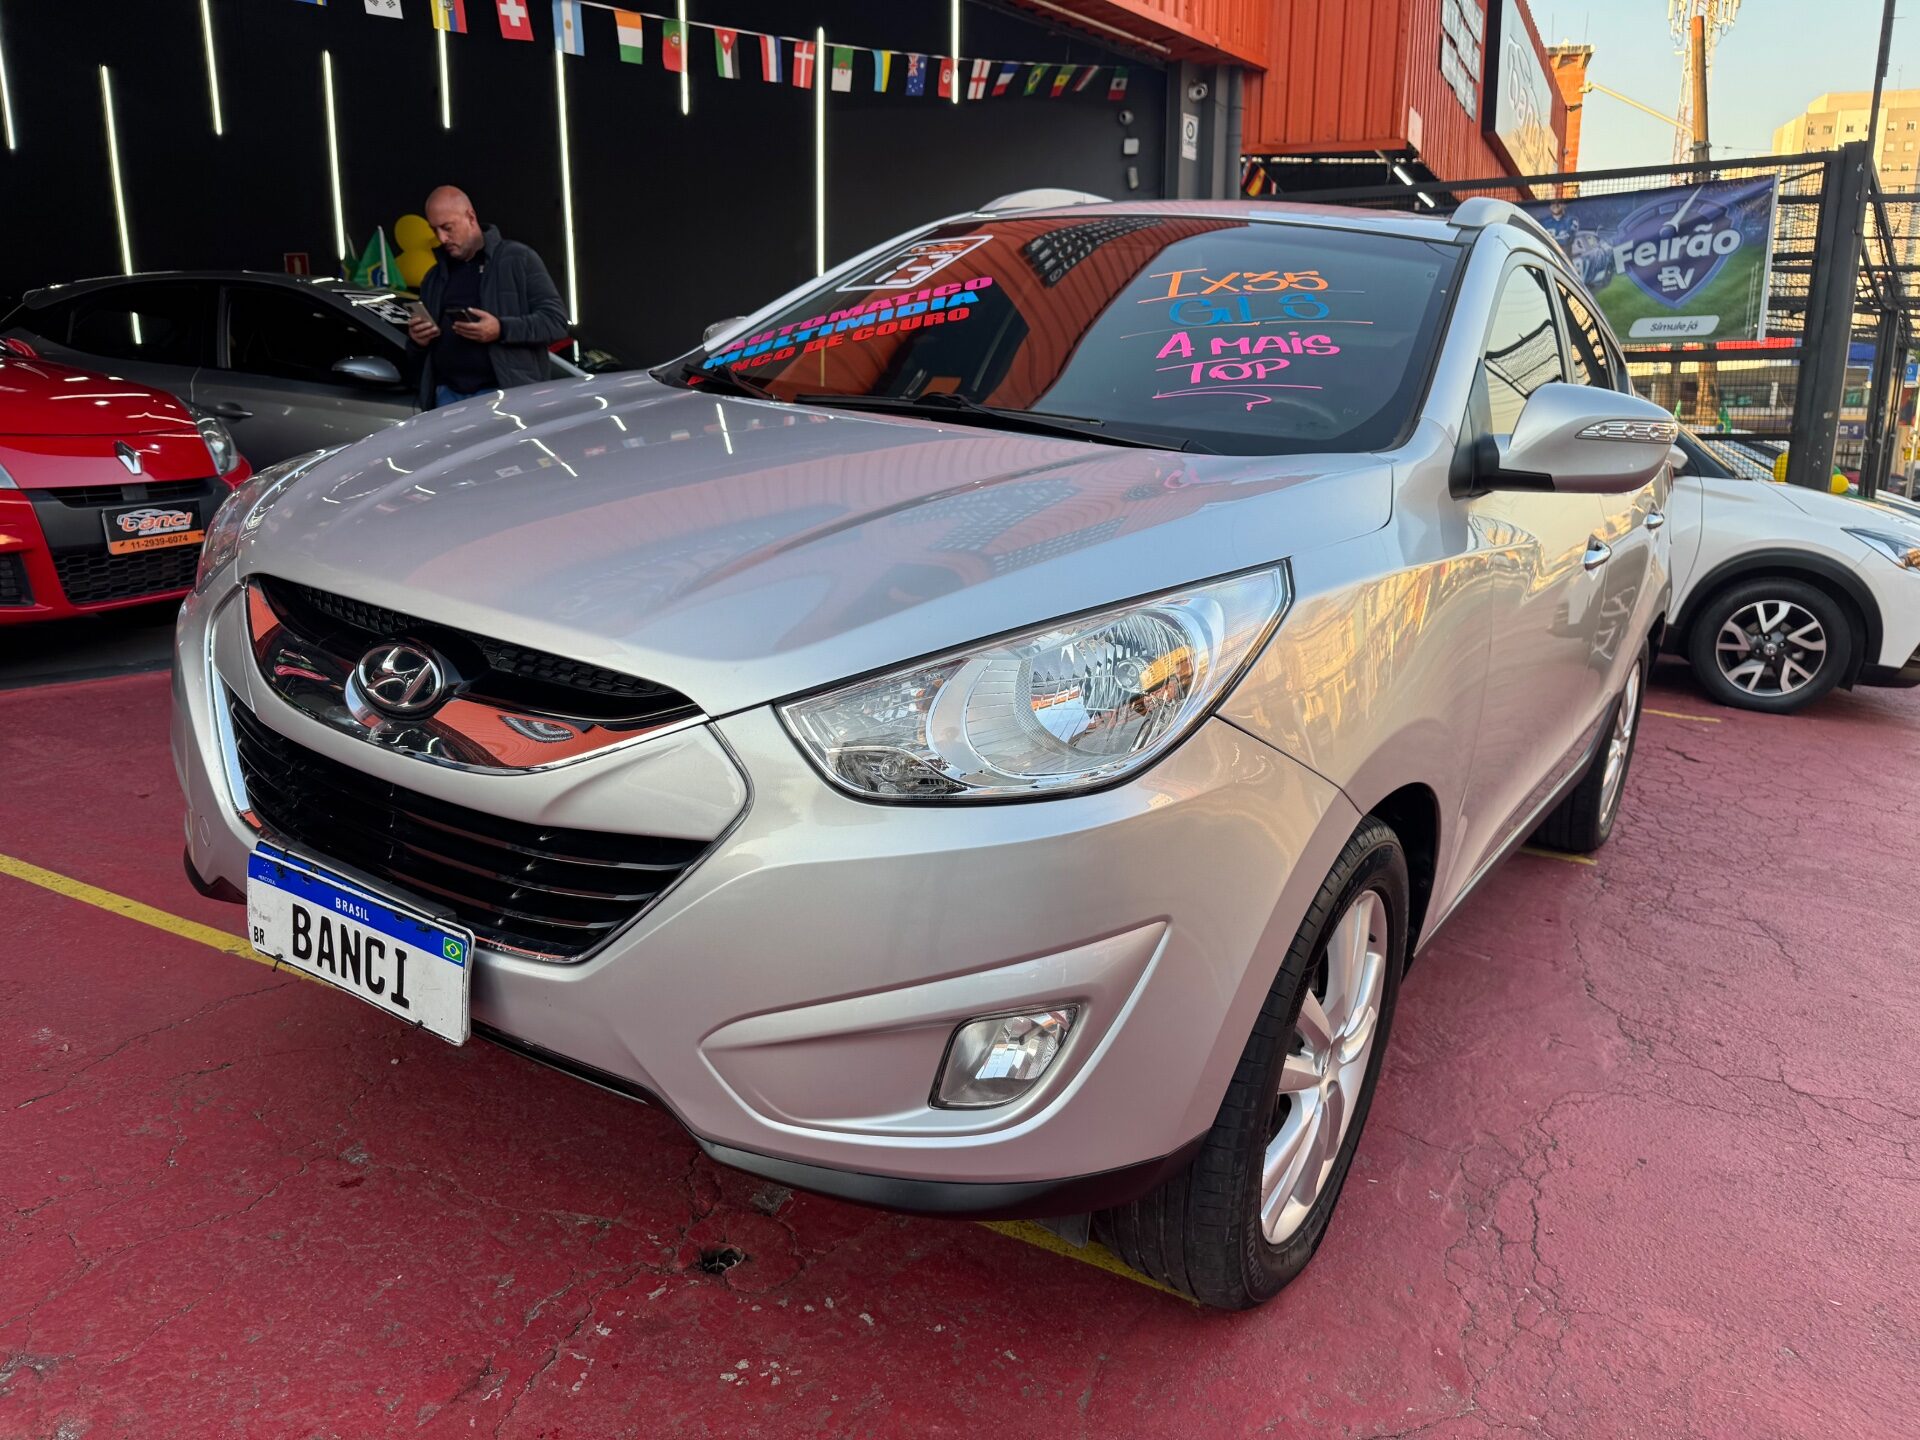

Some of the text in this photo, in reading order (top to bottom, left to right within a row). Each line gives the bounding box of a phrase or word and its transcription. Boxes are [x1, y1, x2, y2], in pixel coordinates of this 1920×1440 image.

[1612, 224, 1741, 275] Feirão
[703, 290, 980, 370] MULTIMIDIA
[724, 276, 993, 353] AUTOMATICO
[803, 334, 845, 354] DE
[852, 307, 970, 342] COURO
[1156, 331, 1195, 359] A
[1156, 358, 1290, 384] TOP
[130, 534, 188, 550] 11-2939-6074
[335, 896, 370, 922] BRASIL
[253, 926, 265, 946] BR
[292, 903, 410, 1010] BANCI
